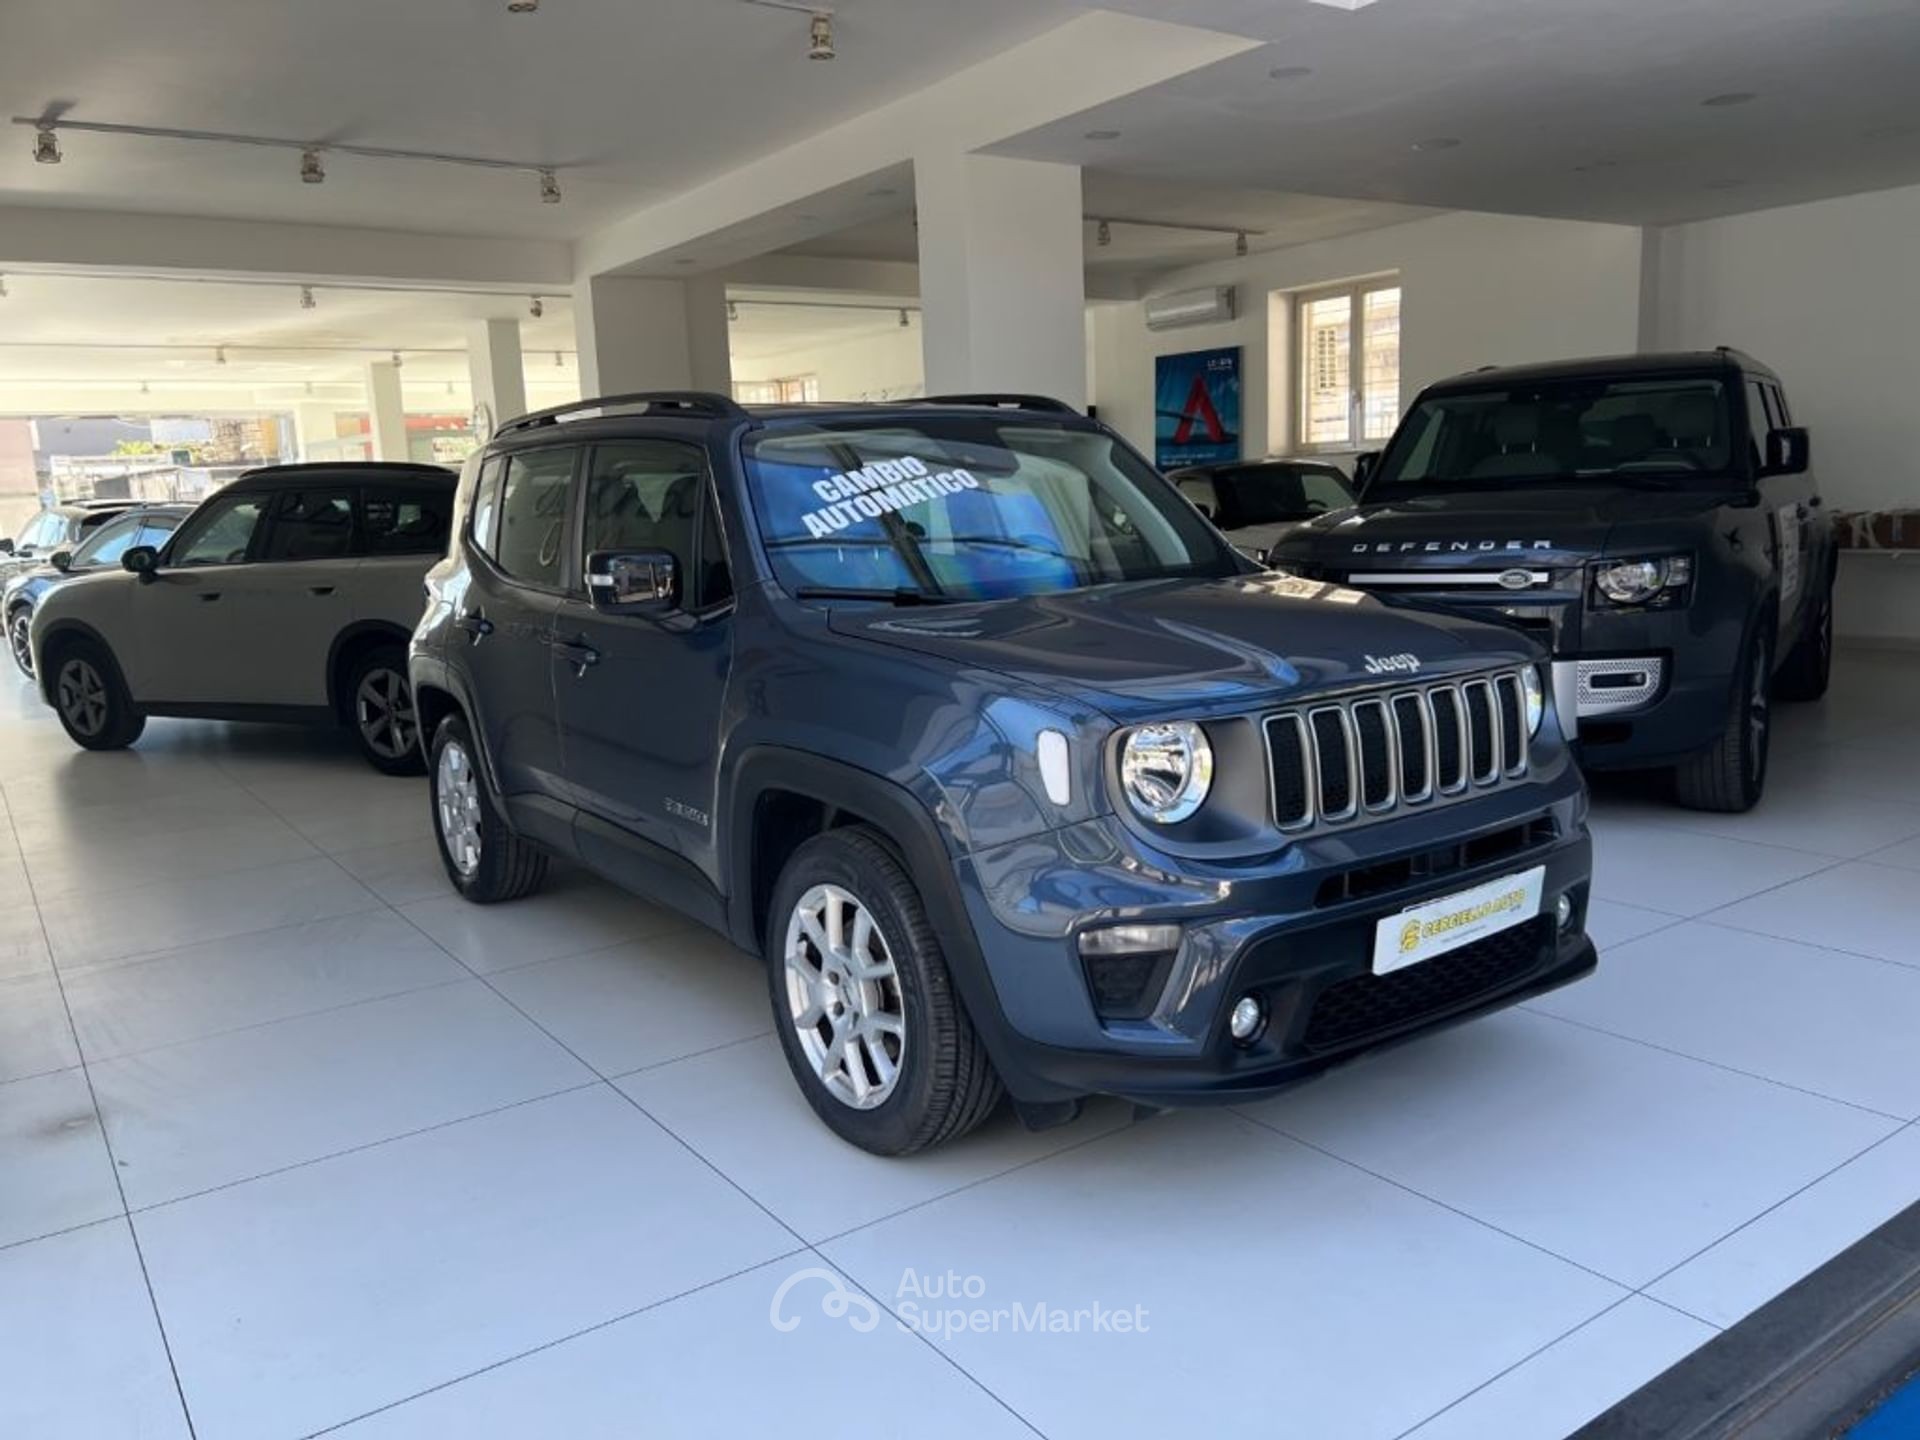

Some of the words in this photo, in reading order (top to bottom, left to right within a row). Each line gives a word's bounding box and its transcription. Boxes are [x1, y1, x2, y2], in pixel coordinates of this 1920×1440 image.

[811, 455, 927, 503] CAMBIO
[801, 468, 979, 539] AUTOMATICO
[1352, 540, 1552, 552] DEFENDER
[1364, 653, 1420, 674] Jeep
